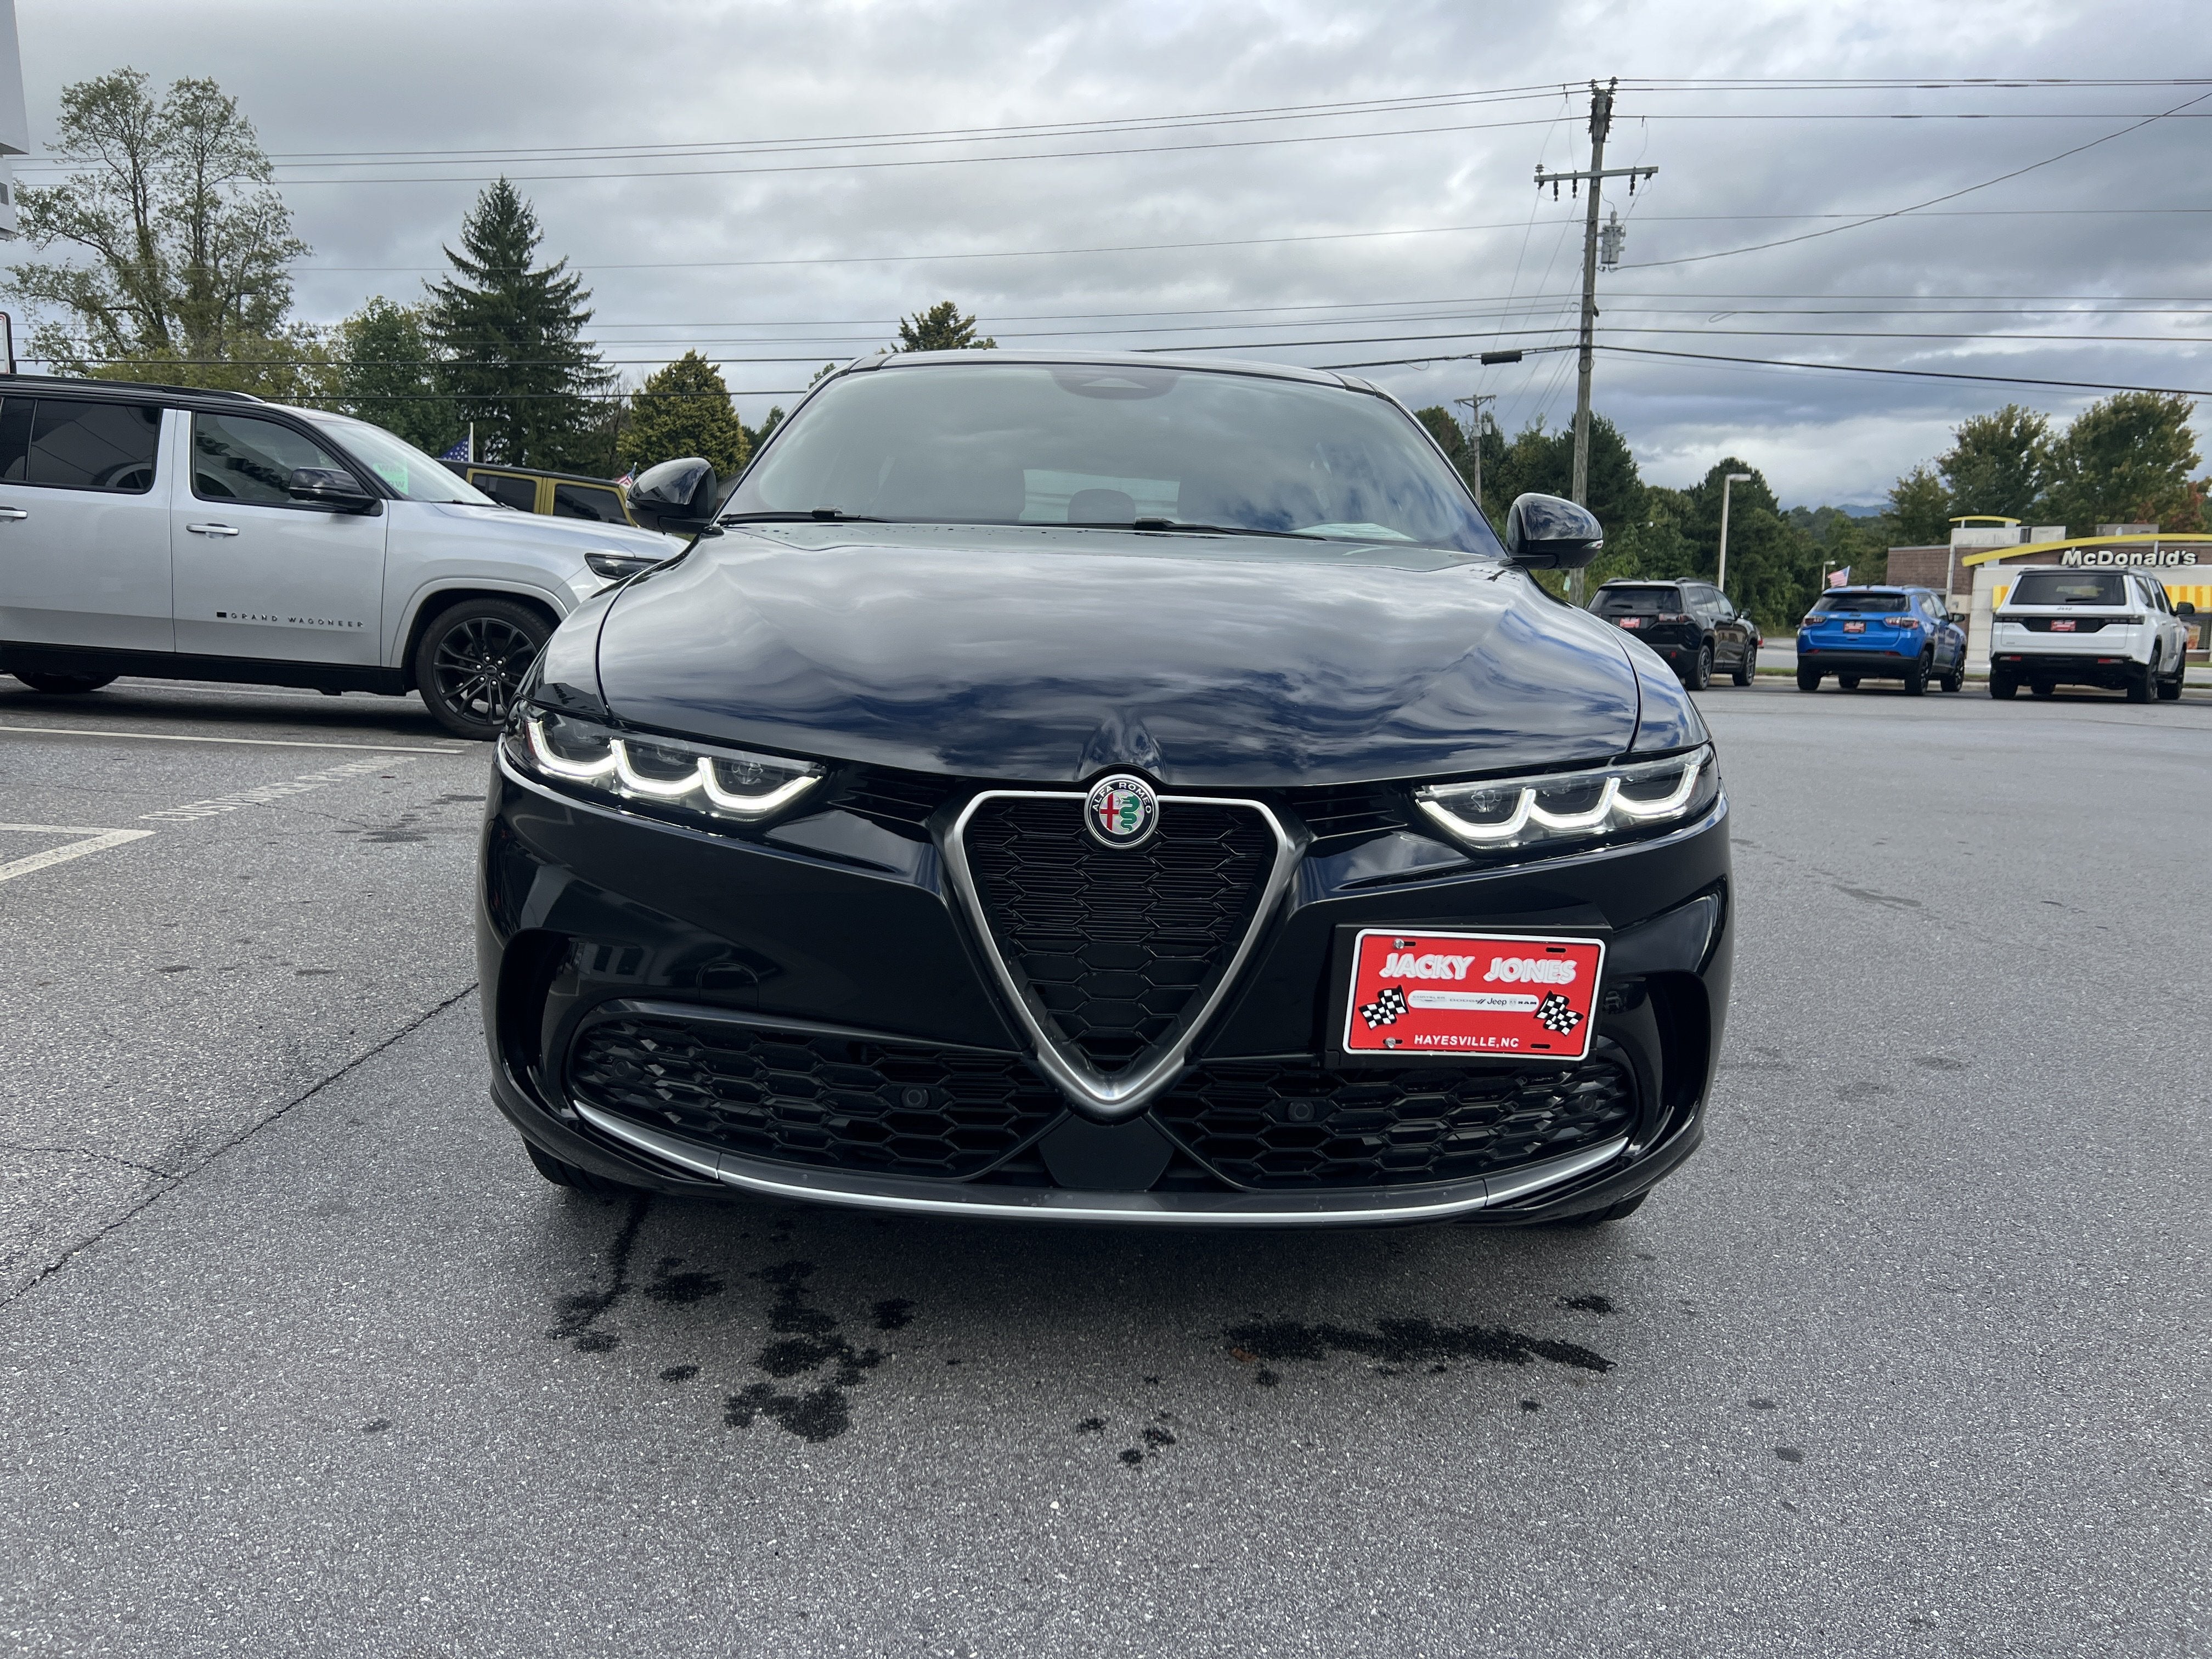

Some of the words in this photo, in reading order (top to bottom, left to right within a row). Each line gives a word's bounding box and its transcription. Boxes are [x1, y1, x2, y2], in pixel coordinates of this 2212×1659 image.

[2061, 549, 2197, 566] McDonald's
[231, 612, 278, 622] GRAND
[288, 617, 364, 628] WAGONEER
[1092, 786, 1114, 812] ALFA
[1119, 782, 1152, 814] ROMEO
[1379, 952, 1475, 980] JACKY
[1483, 957, 1577, 985] JONES
[1487, 997, 1507, 1006] Jeep
